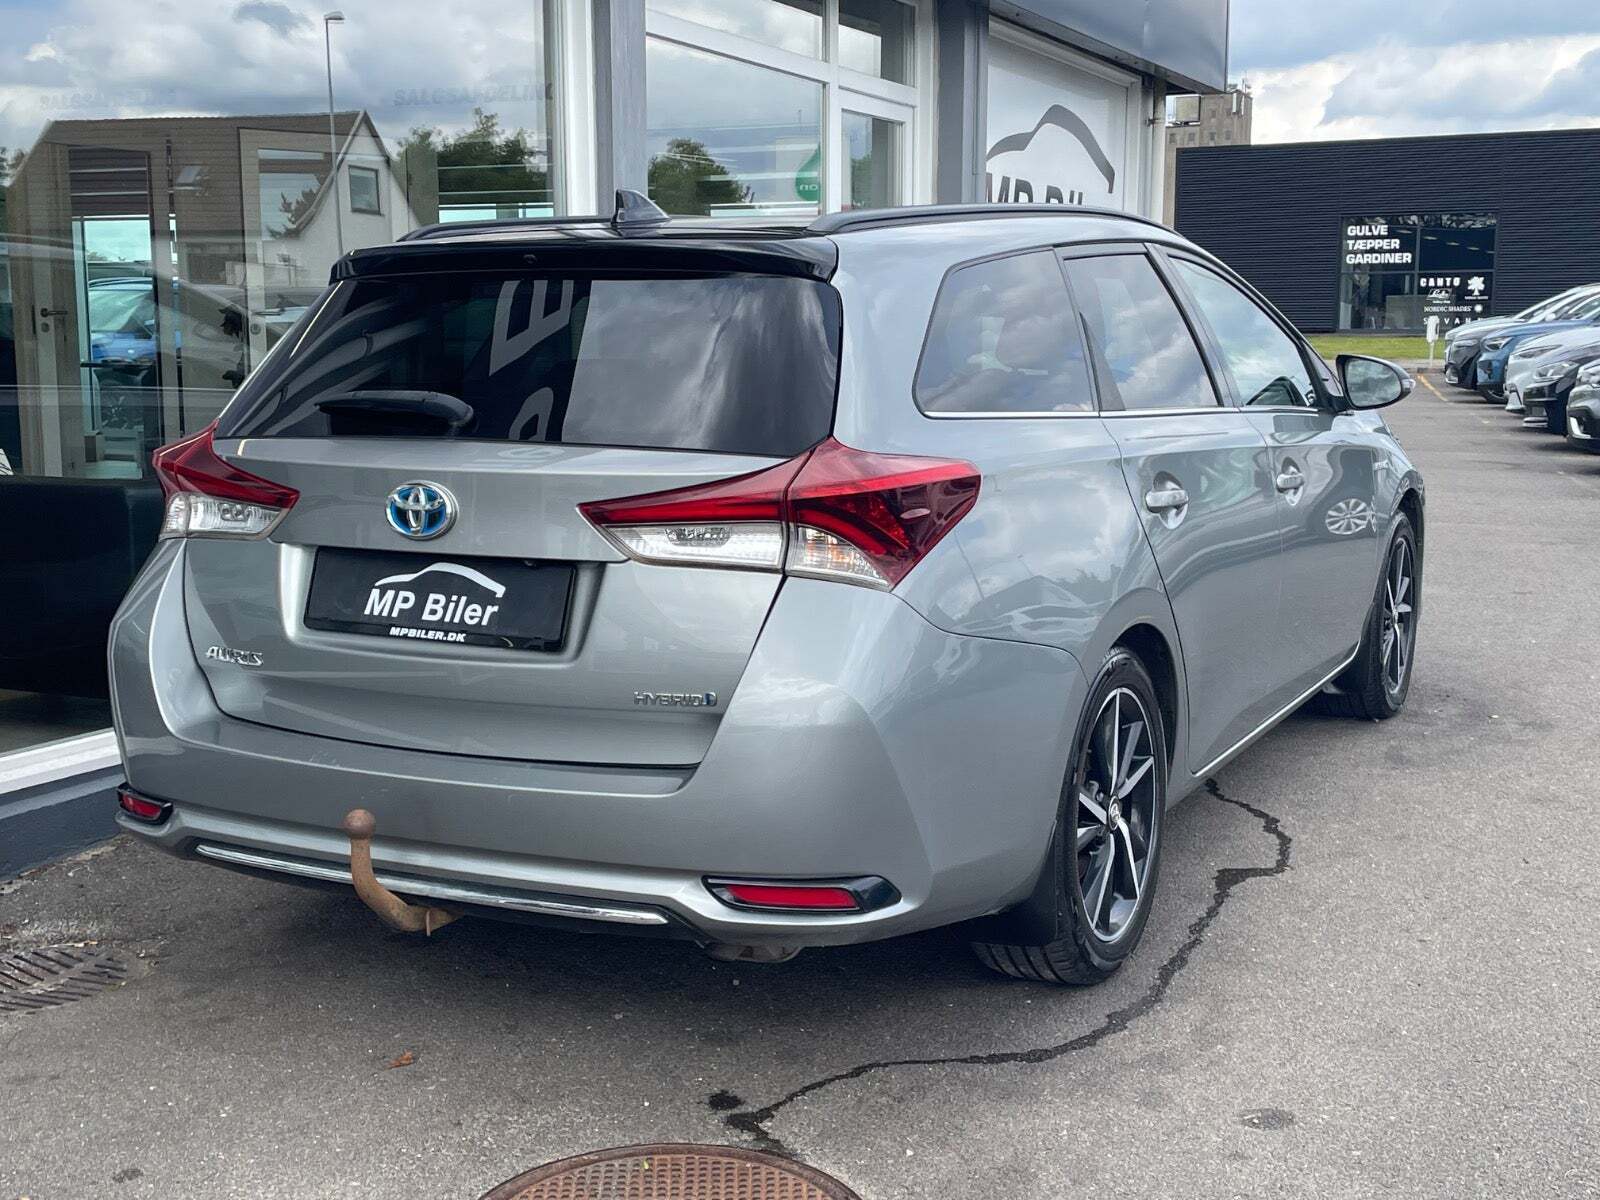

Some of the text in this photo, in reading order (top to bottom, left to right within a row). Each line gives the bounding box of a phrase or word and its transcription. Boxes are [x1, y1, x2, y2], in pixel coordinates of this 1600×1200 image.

[1347, 225, 1388, 236] GULVE
[1347, 239, 1400, 250] TÆPPER
[1346, 253, 1412, 264] GARDINER
[1420, 277, 1461, 287] CANTO
[364, 588, 499, 626] MP Biler
[389, 626, 466, 642] MPBILER.DK
[205, 646, 263, 666] AURIS
